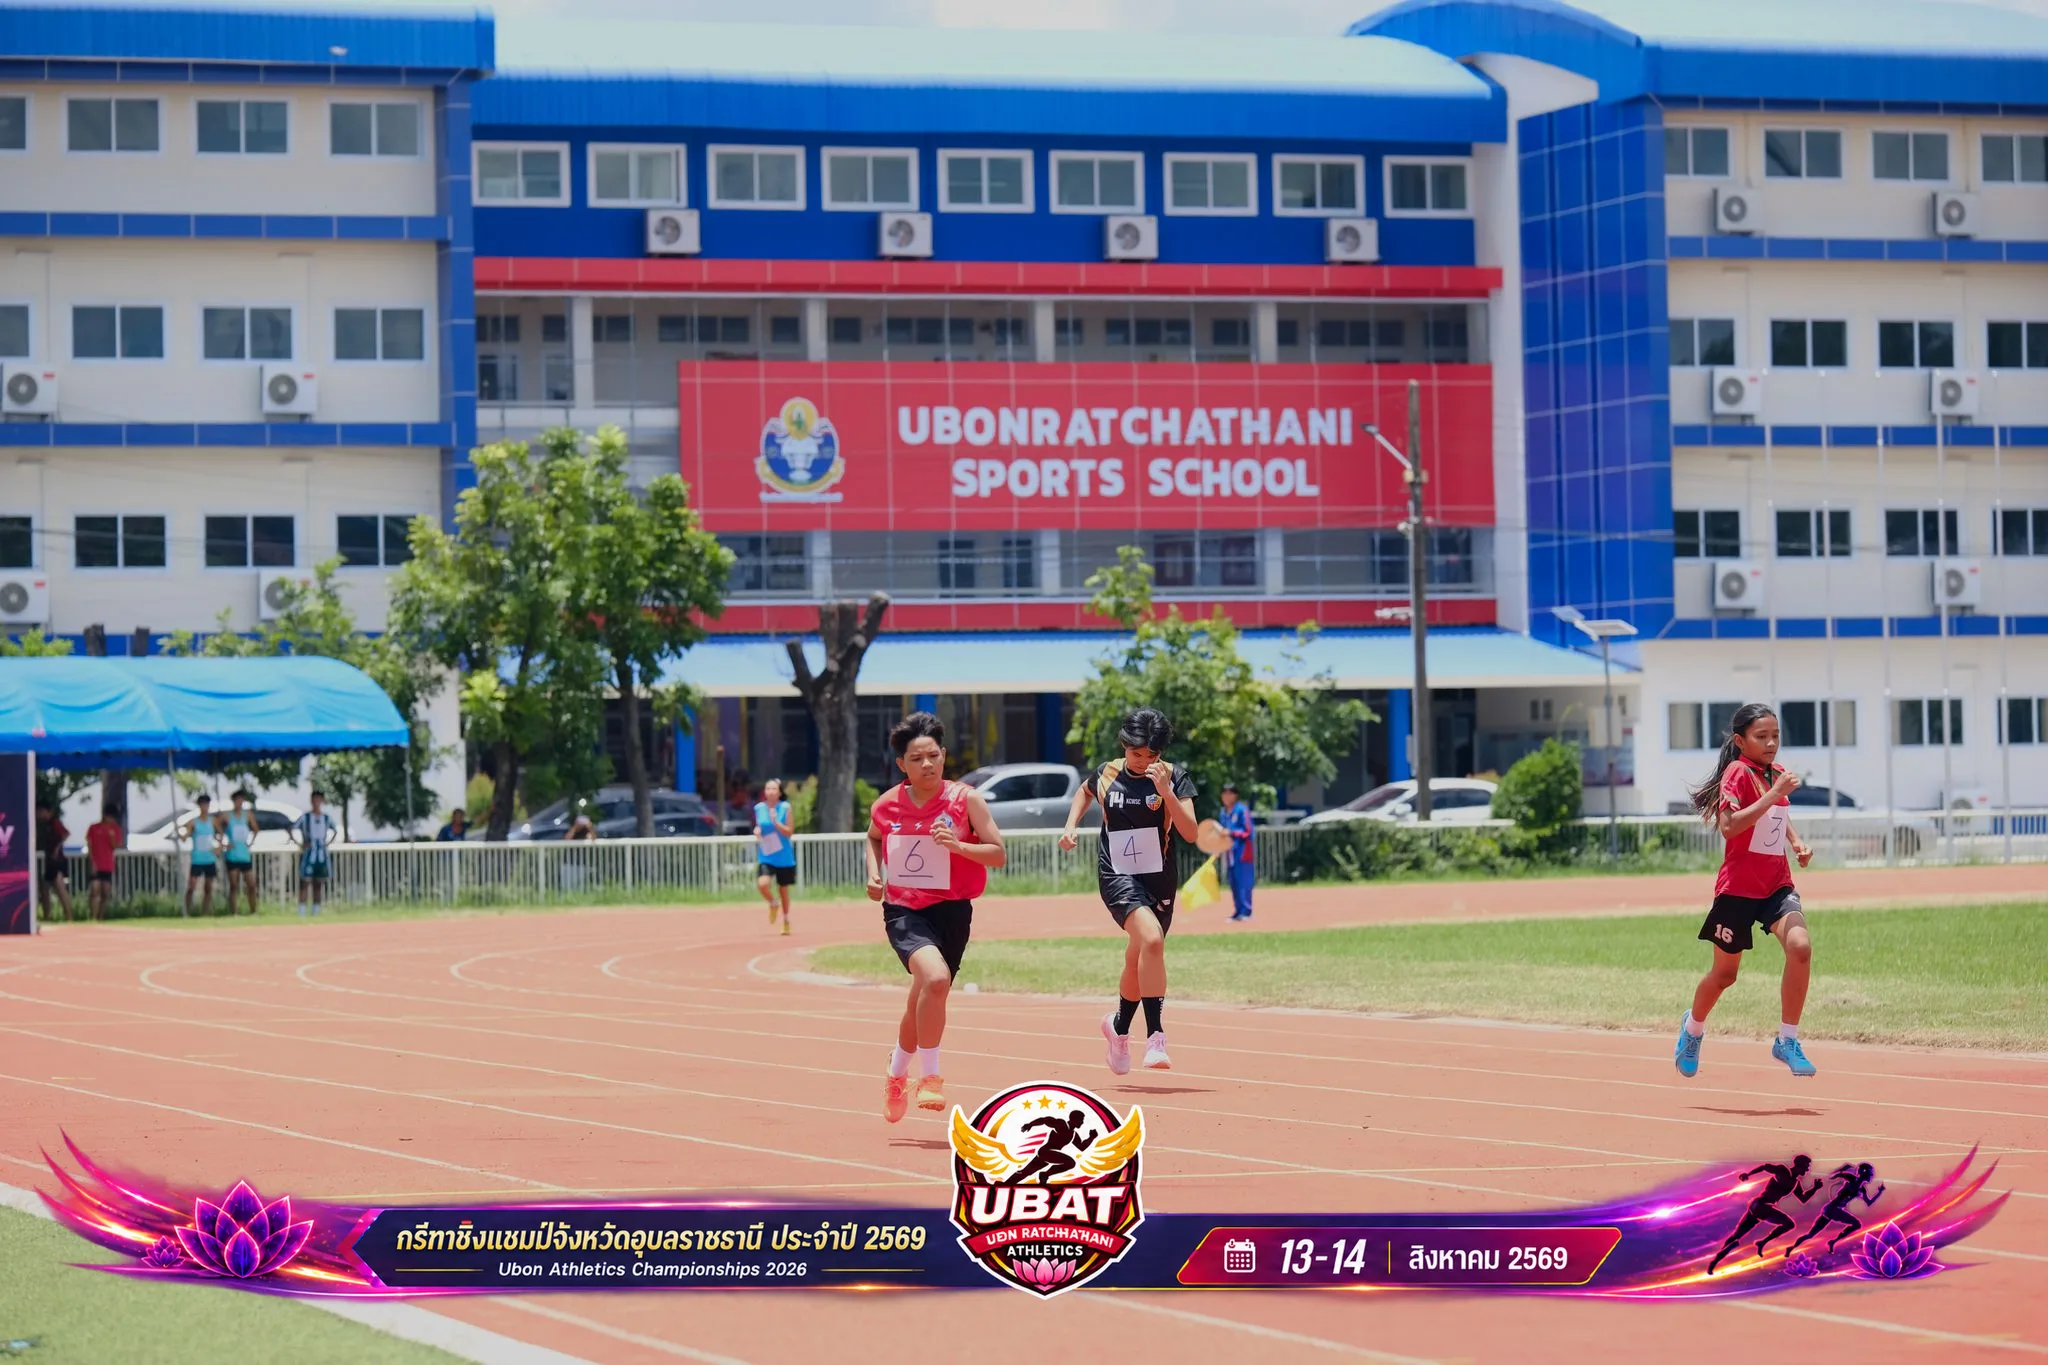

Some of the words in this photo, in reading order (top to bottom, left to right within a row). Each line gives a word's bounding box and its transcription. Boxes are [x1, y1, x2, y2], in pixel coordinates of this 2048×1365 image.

[898, 406, 1352, 447] UBONRATCHATHANI
[951, 458, 1125, 497] SPORTS
[1148, 458, 1320, 497] SCHOOL
[1108, 791, 1124, 809] 14
[1763, 816, 1783, 848] 3
[904, 839, 925, 873] 6
[1122, 835, 1143, 864] 4
[1714, 923, 1734, 944] 16
